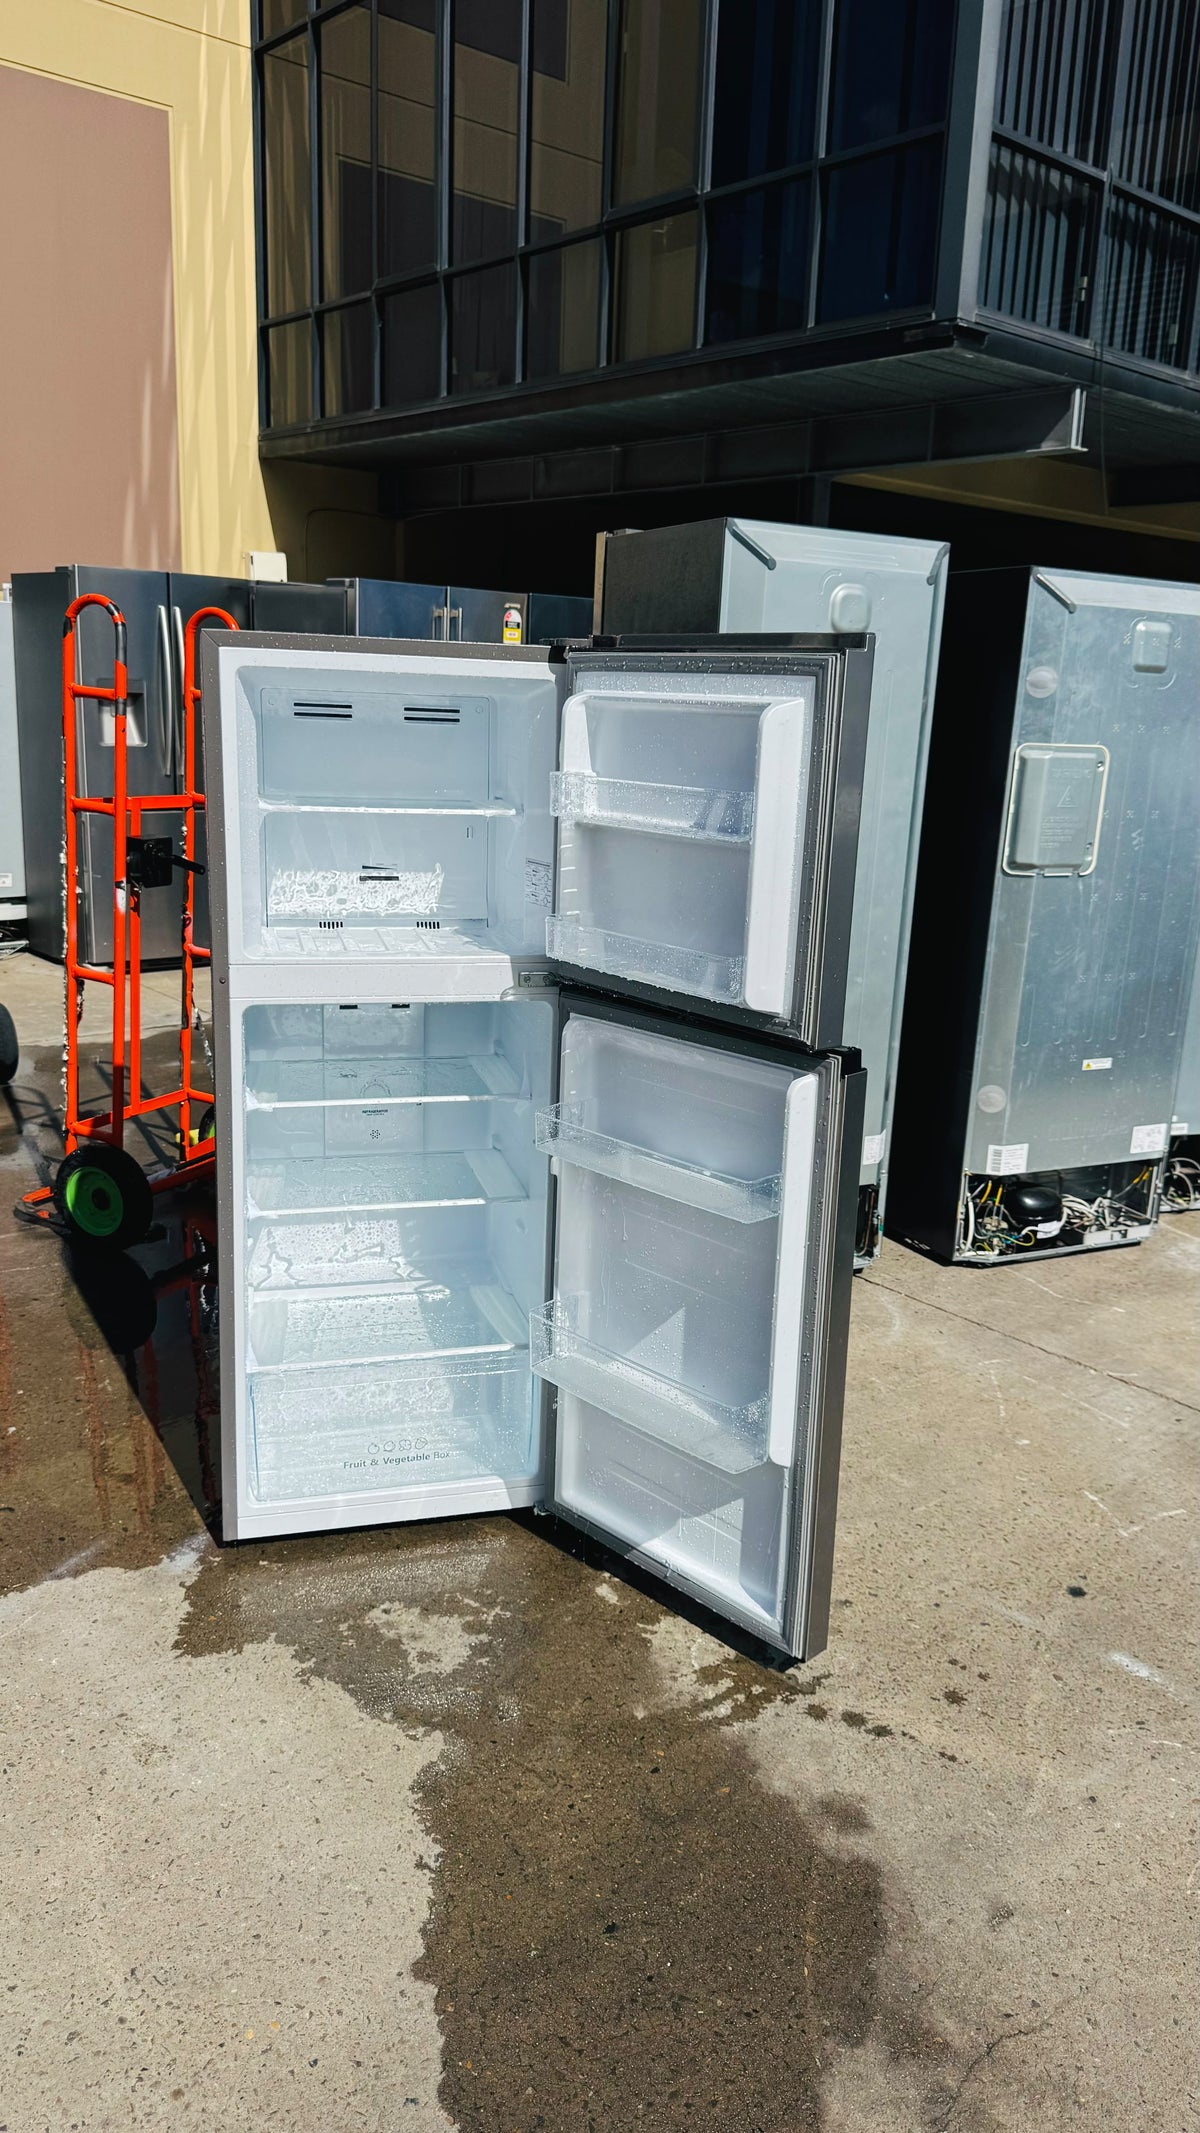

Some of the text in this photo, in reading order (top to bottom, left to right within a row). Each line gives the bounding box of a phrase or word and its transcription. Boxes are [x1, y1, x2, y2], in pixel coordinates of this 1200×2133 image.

[343, 1460, 367, 1469] Fruit
[383, 1453, 430, 1465] Vegetable
[433, 1451, 450, 1459] Box
